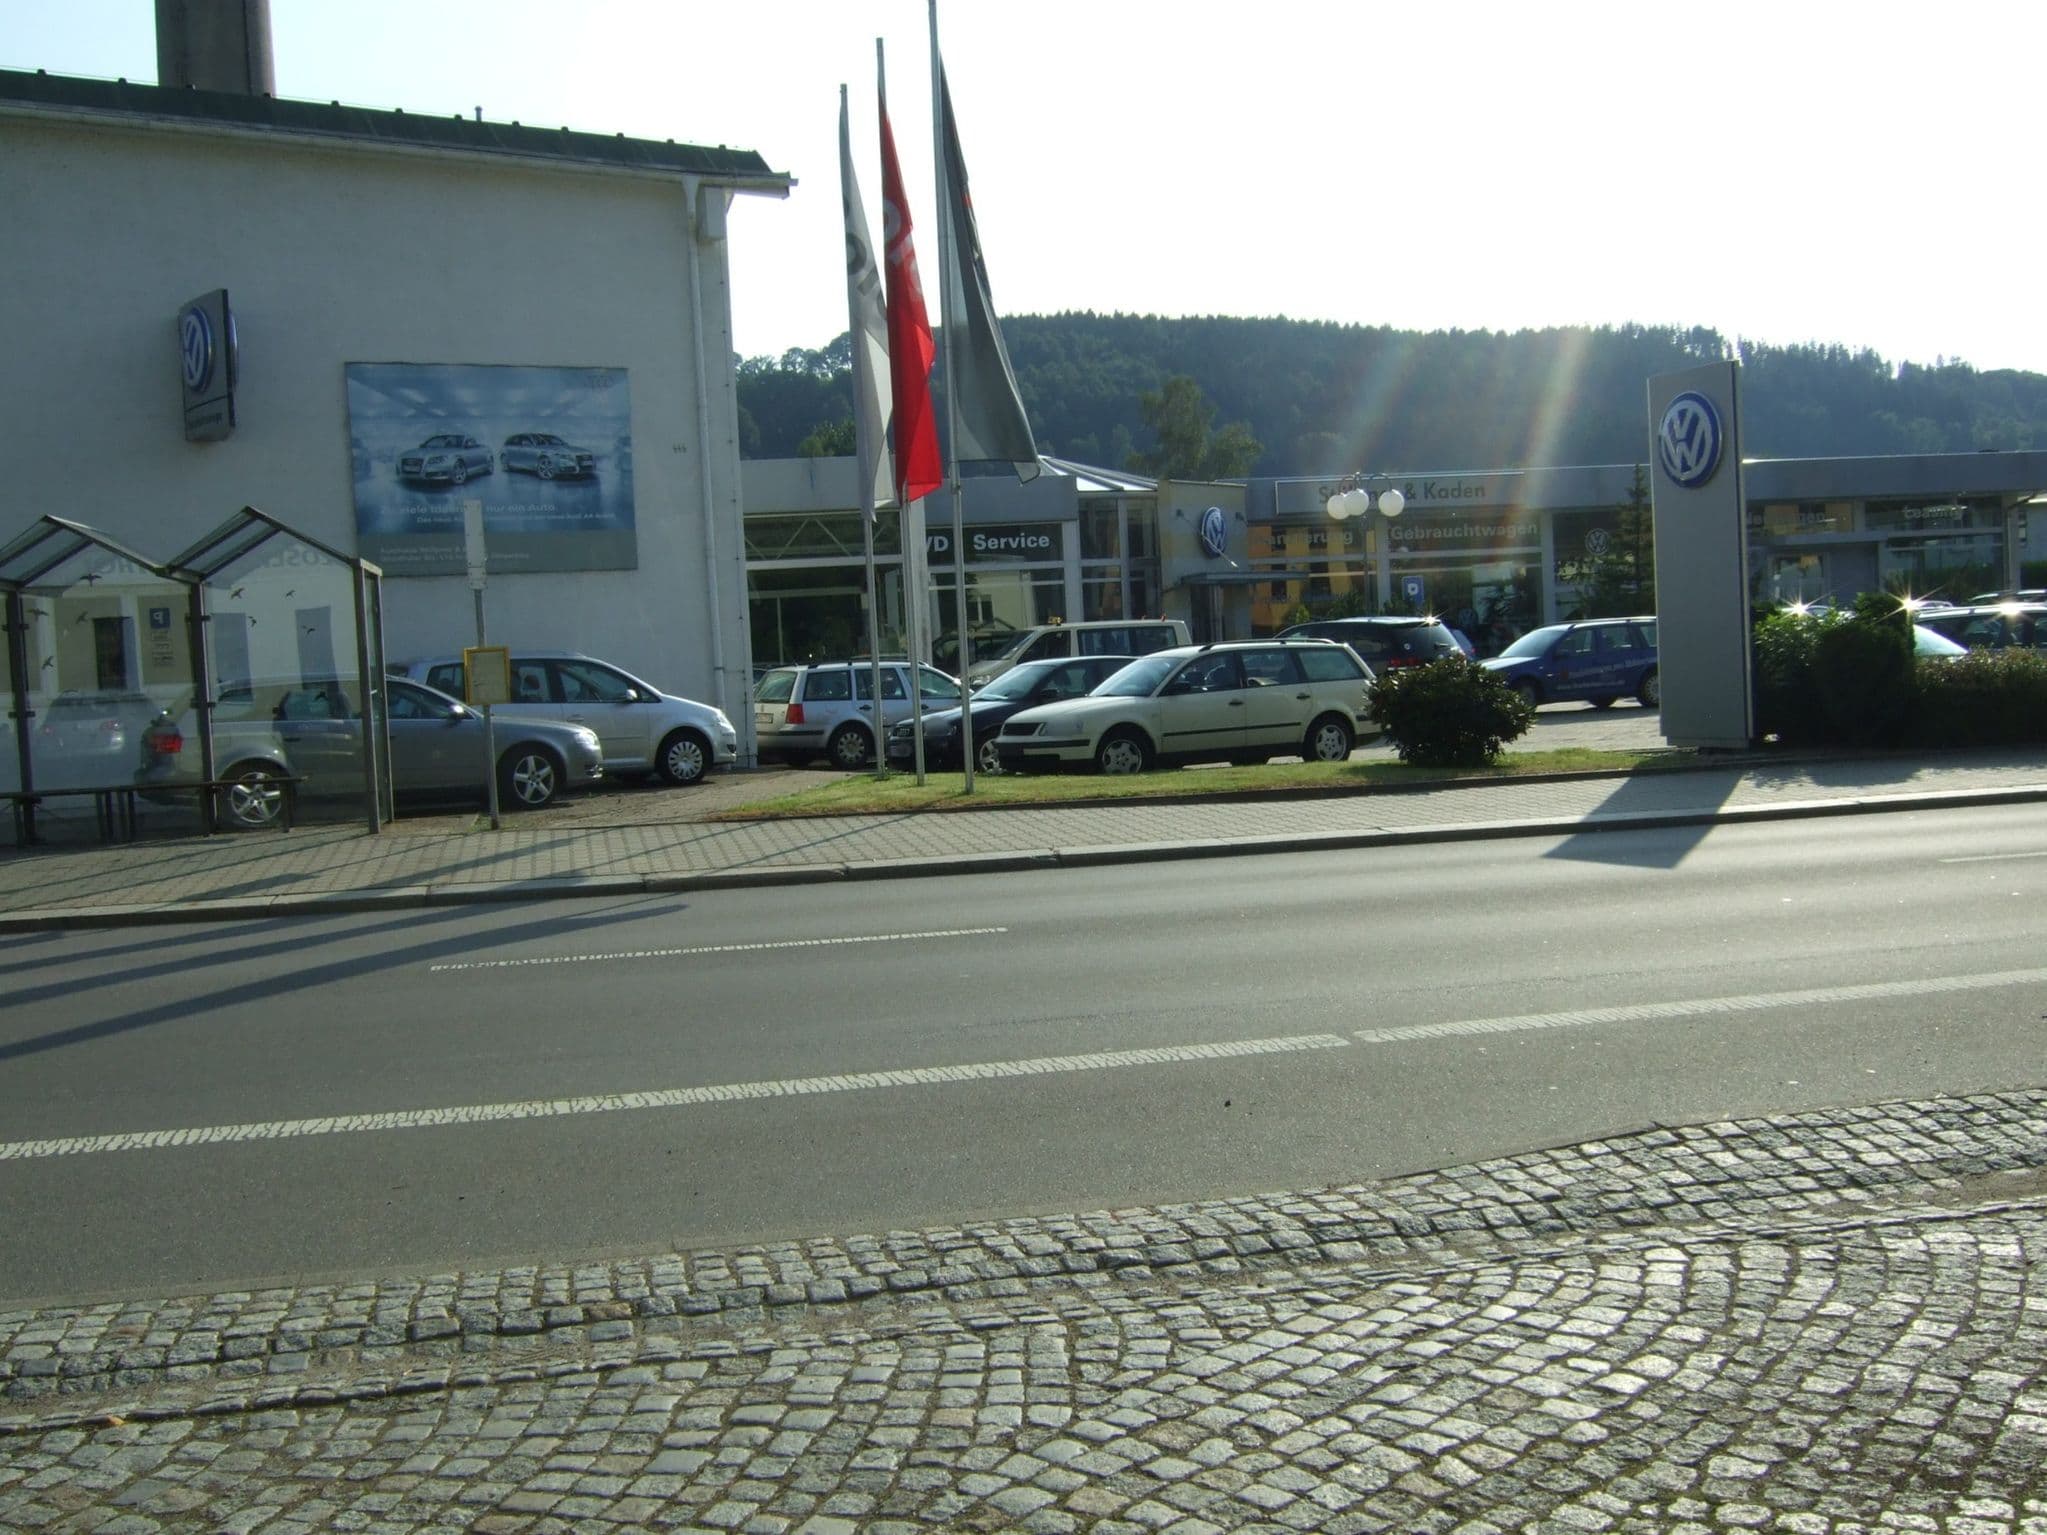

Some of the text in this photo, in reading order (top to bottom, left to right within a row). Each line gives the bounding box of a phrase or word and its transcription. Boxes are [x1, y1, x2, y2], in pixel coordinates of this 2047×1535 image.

[1424, 480, 1486, 499] Kaden
[1390, 523, 1538, 541] Gebrauchtwagen
[973, 533, 1050, 551] Service
